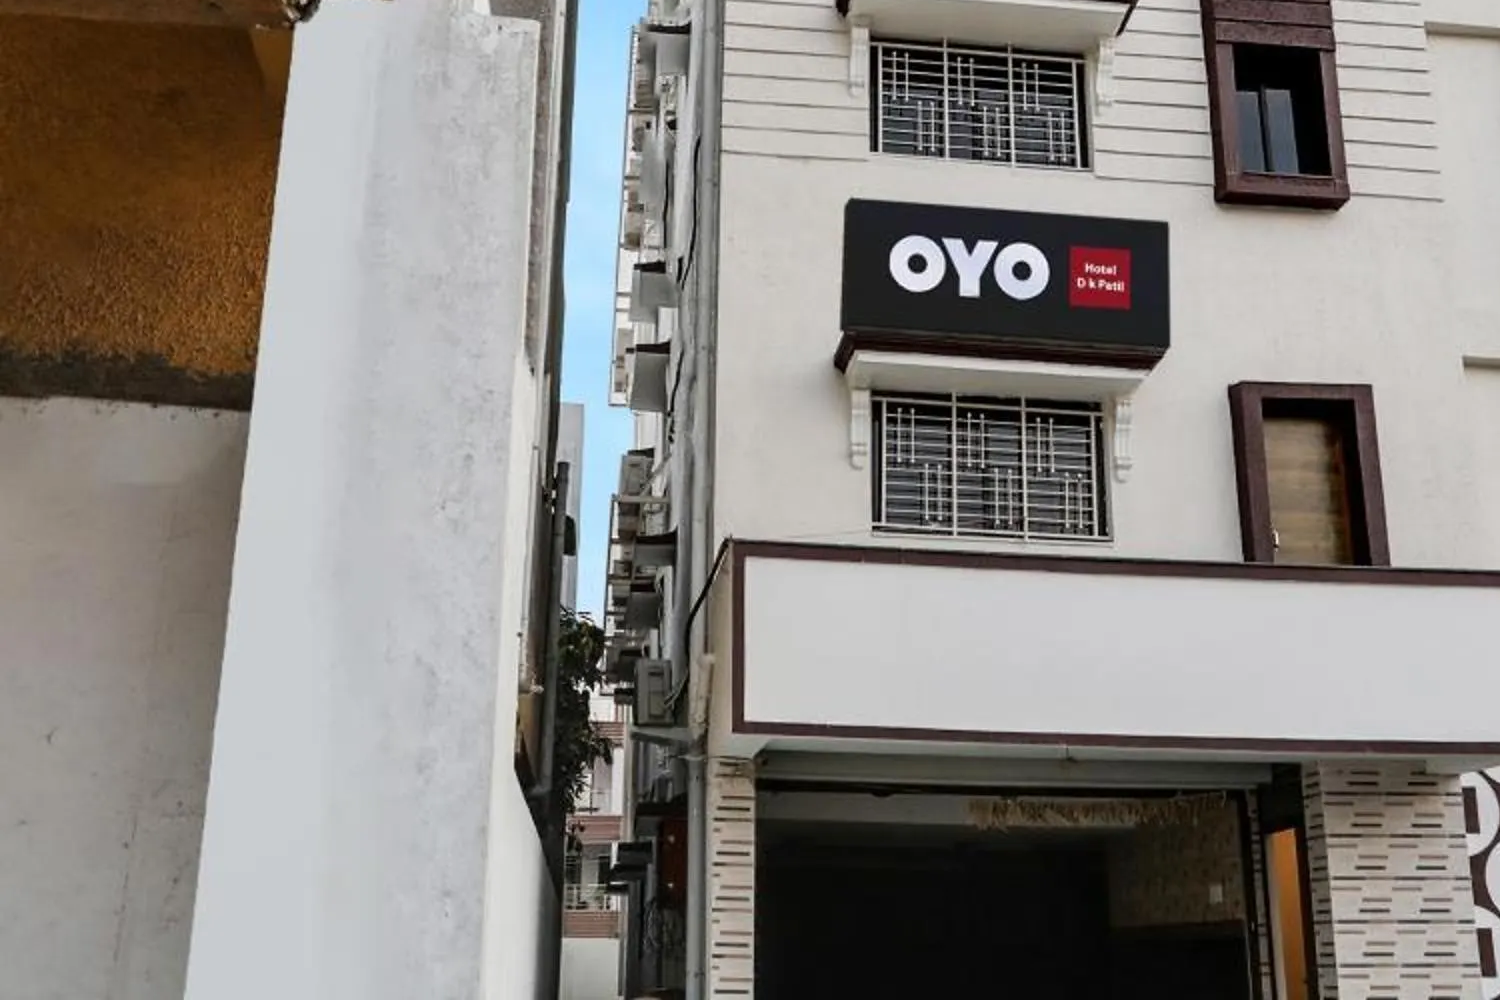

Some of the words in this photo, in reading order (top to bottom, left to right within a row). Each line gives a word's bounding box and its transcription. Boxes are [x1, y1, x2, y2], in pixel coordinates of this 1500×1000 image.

[889, 235, 1050, 300] OYO
[1085, 263, 1117, 275] Hotel
[1077, 277, 1087, 289] D
[1098, 279, 1125, 292] Patil
